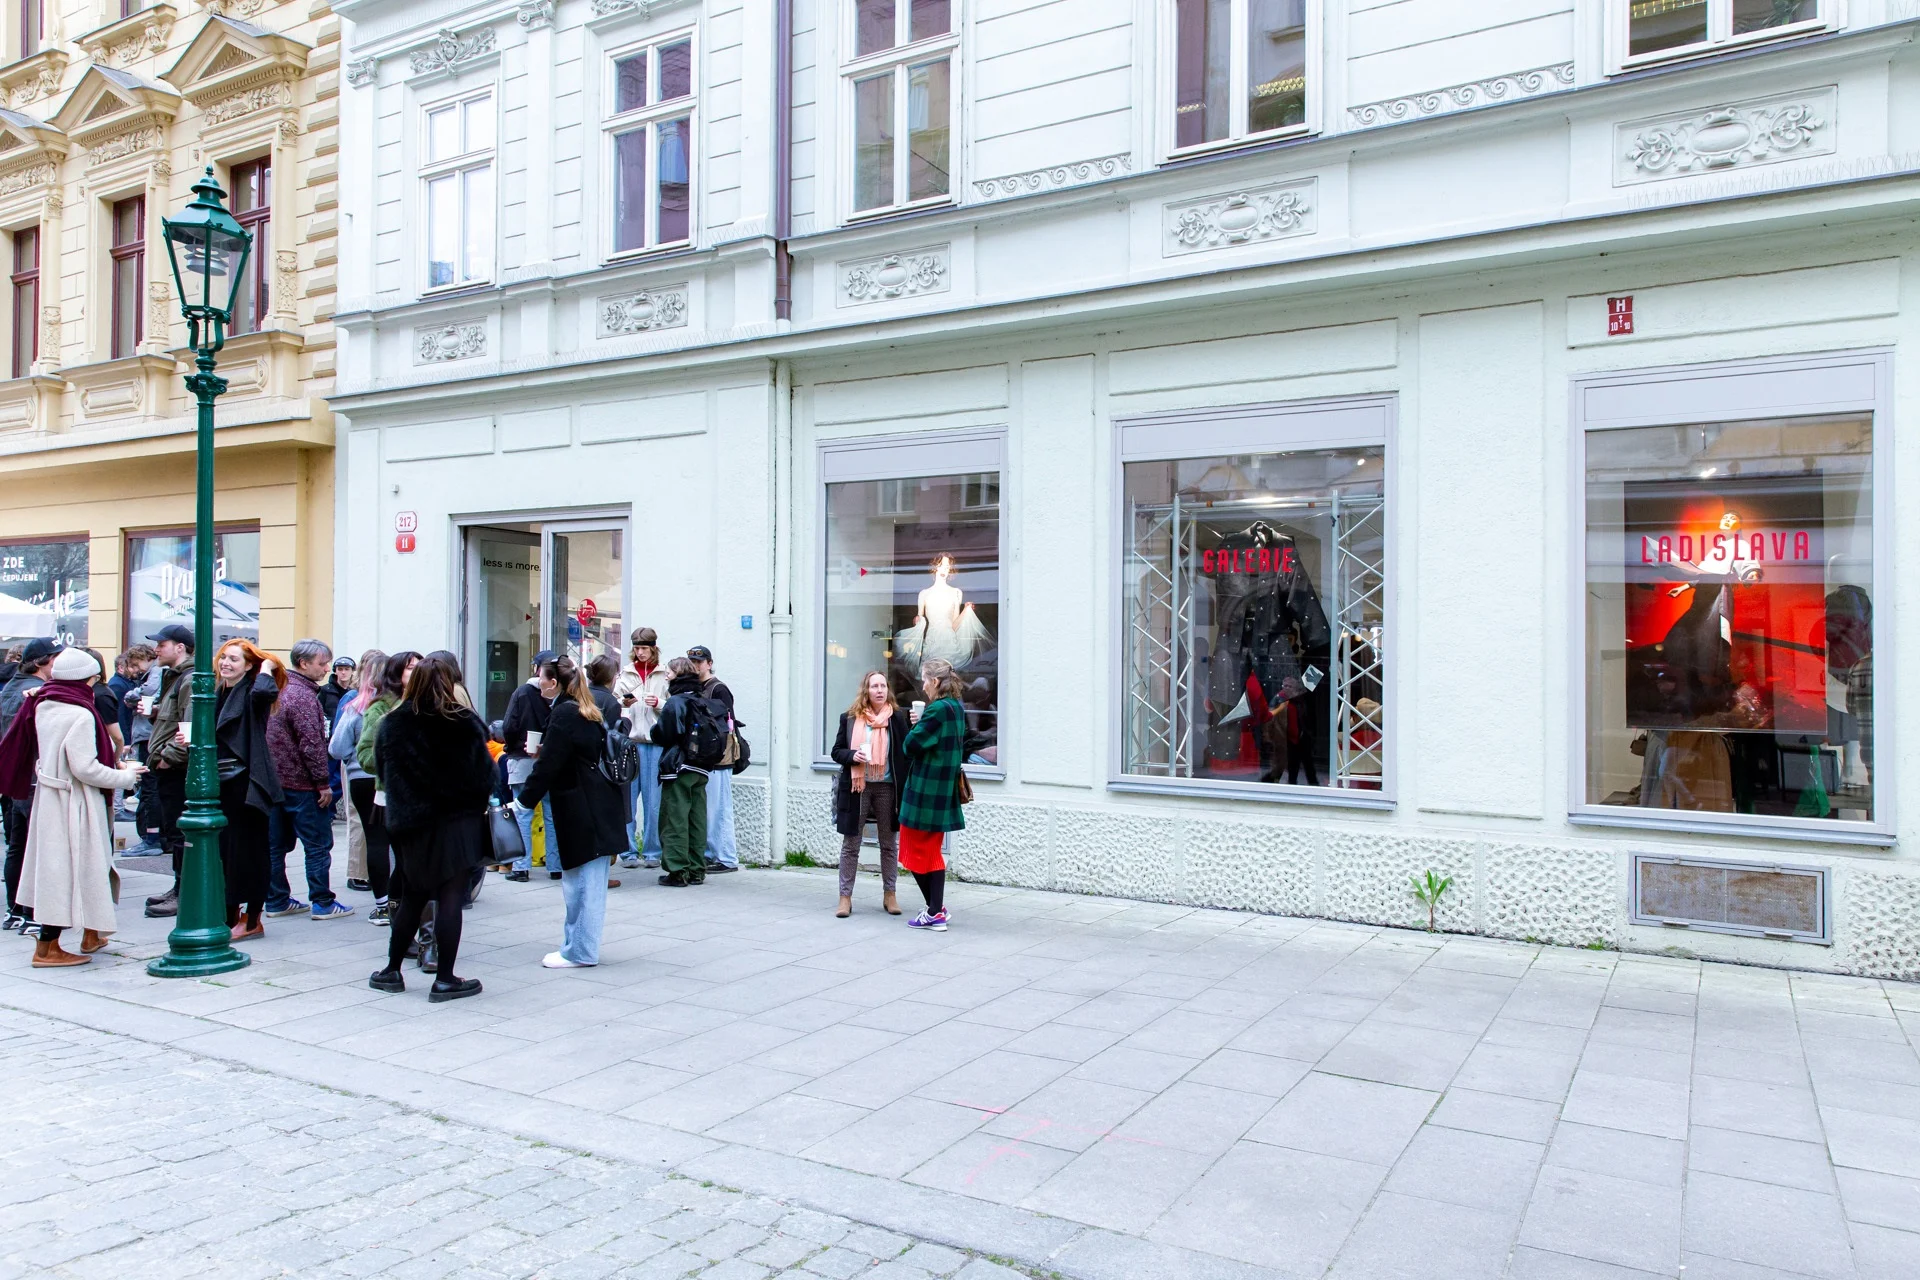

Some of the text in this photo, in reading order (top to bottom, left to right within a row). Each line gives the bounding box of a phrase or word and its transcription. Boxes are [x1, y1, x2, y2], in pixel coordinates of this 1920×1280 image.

[1616, 299, 1626, 312] H
[1611, 322, 1619, 331] 10
[399, 516, 411, 527] 217
[401, 537, 409, 549] 11
[1641, 531, 1809, 563] LADISLAVA
[3, 557, 25, 568] ZDE
[483, 557, 542, 571] less is more.
[1203, 547, 1294, 573] GALERIE
[2, 572, 39, 582] ČEPUJEME
[161, 557, 227, 605] Drua
